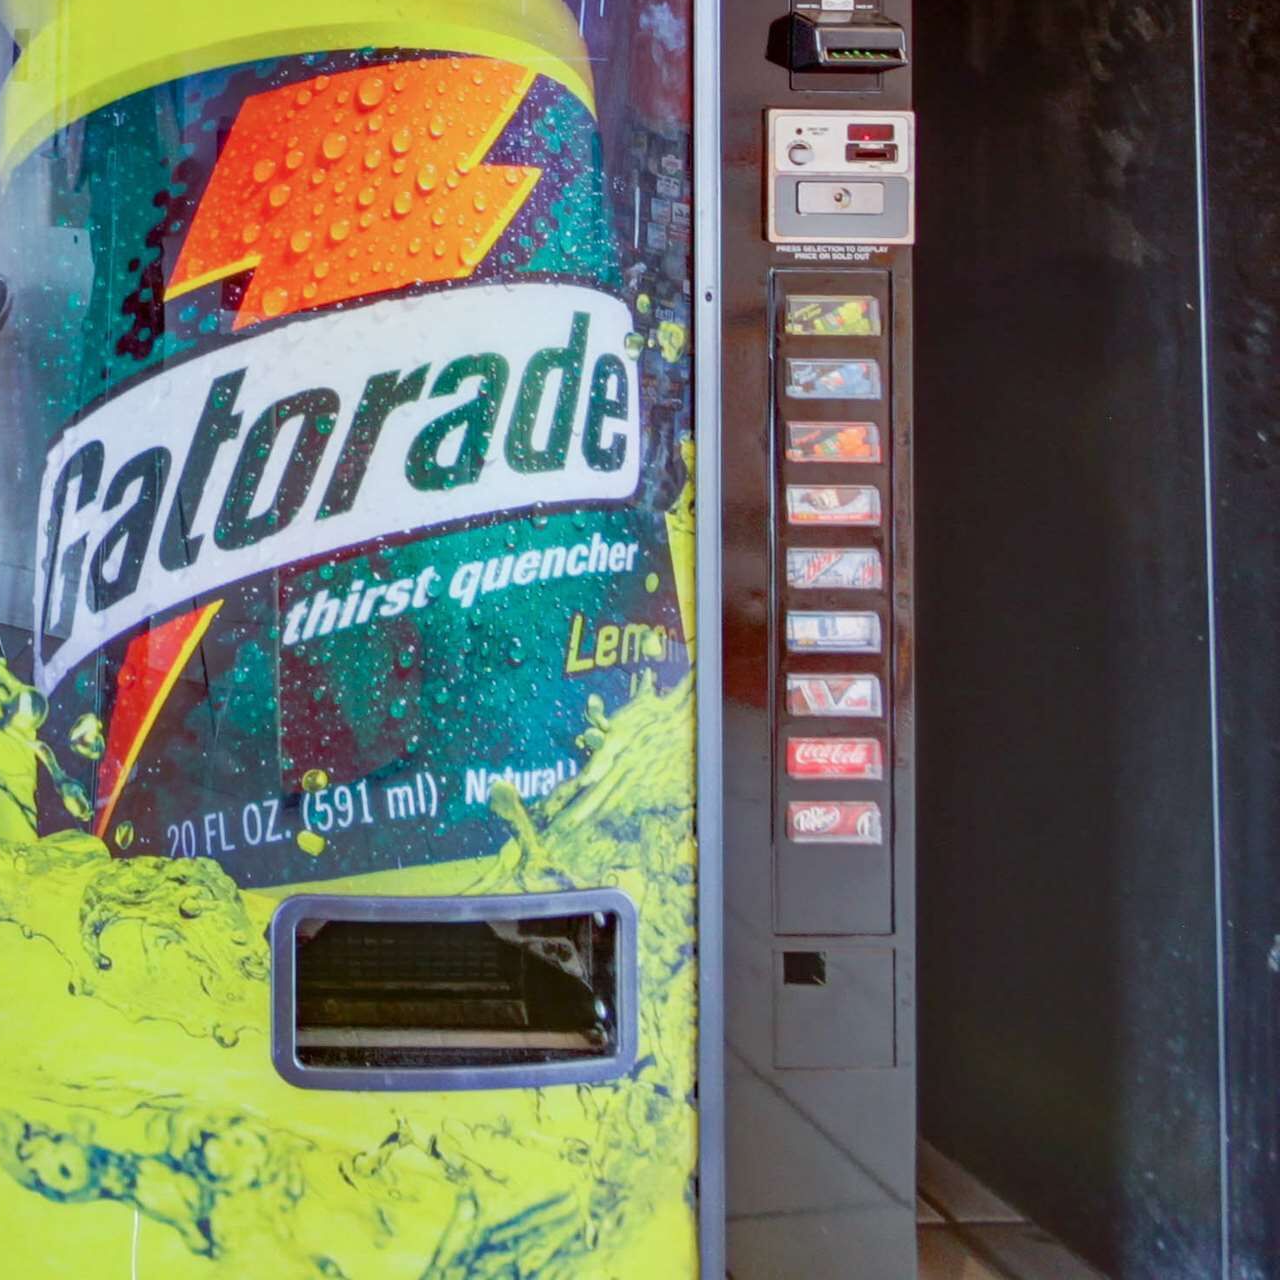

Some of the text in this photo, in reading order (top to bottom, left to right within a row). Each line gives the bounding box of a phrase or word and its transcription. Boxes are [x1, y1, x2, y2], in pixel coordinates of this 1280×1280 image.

[803, 245, 844, 253] SELECTION
[42, 310, 630, 641] Gatorade
[279, 532, 640, 646] thirst quencher
[203, 811, 236, 854] FL
[242, 799, 292, 846] OZ.
[386, 771, 438, 820] ml)
